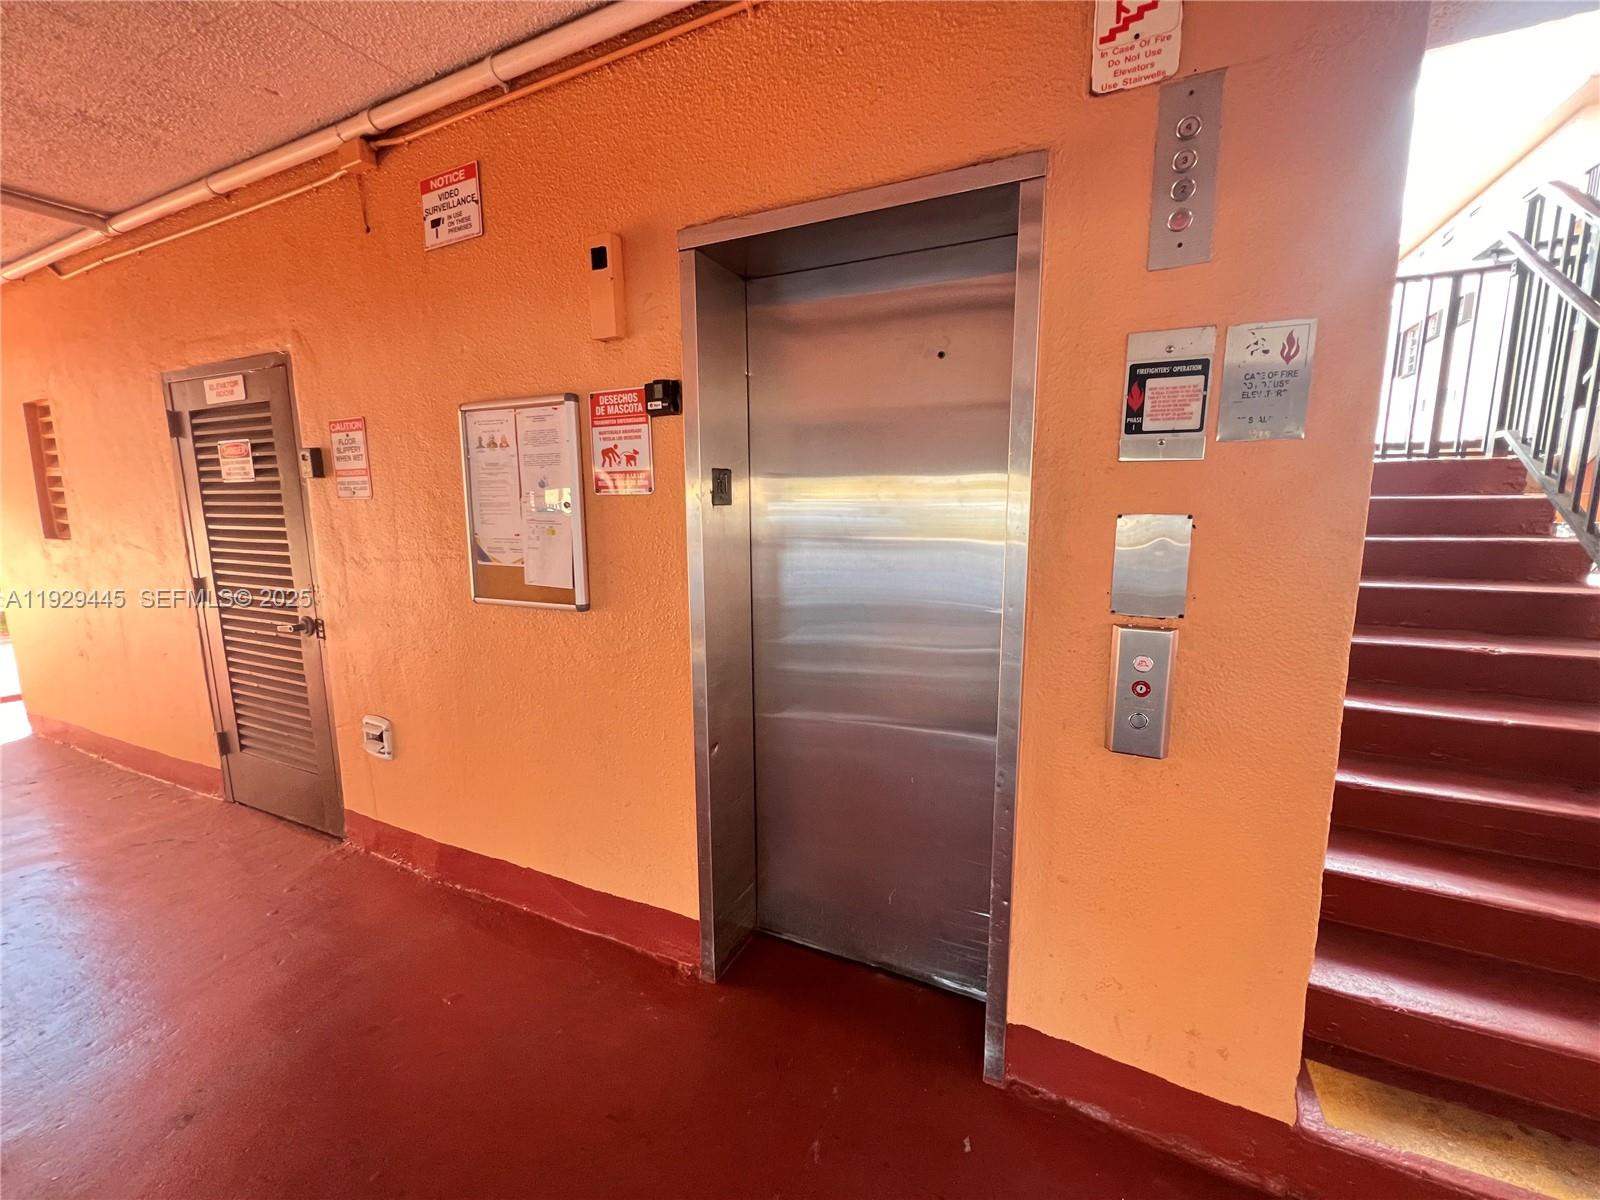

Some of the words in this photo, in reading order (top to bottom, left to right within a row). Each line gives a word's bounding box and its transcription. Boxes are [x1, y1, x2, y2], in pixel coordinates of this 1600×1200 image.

[1100, 51, 1108, 59] In
[1112, 45, 1135, 55] Case
[1139, 38, 1150, 48] Of
[1155, 34, 1172, 44] Fire
[1108, 59, 1120, 68] Do
[1124, 53, 1140, 64] Not
[1144, 48, 1162, 58] Use
[1113, 62, 1155, 77] Elevators
[1101, 82, 1118, 91] Use
[1122, 70, 1167, 86] Stairwells
[430, 168, 465, 190] NOTICE
[438, 188, 459, 202] VIDEO
[424, 193, 476, 217] SURVEILLANCE
[1173, 364, 1202, 373] OPERATION
[1280, 369, 1299, 378] FIRE
[599, 392, 638, 405] DESECHOS
[595, 406, 606, 416] DE
[607, 403, 643, 415] MASCOTA
[330, 421, 362, 432] CAUTION
[337, 437, 356, 446] FLOOR
[336, 446, 361, 454] SLIPPERY
